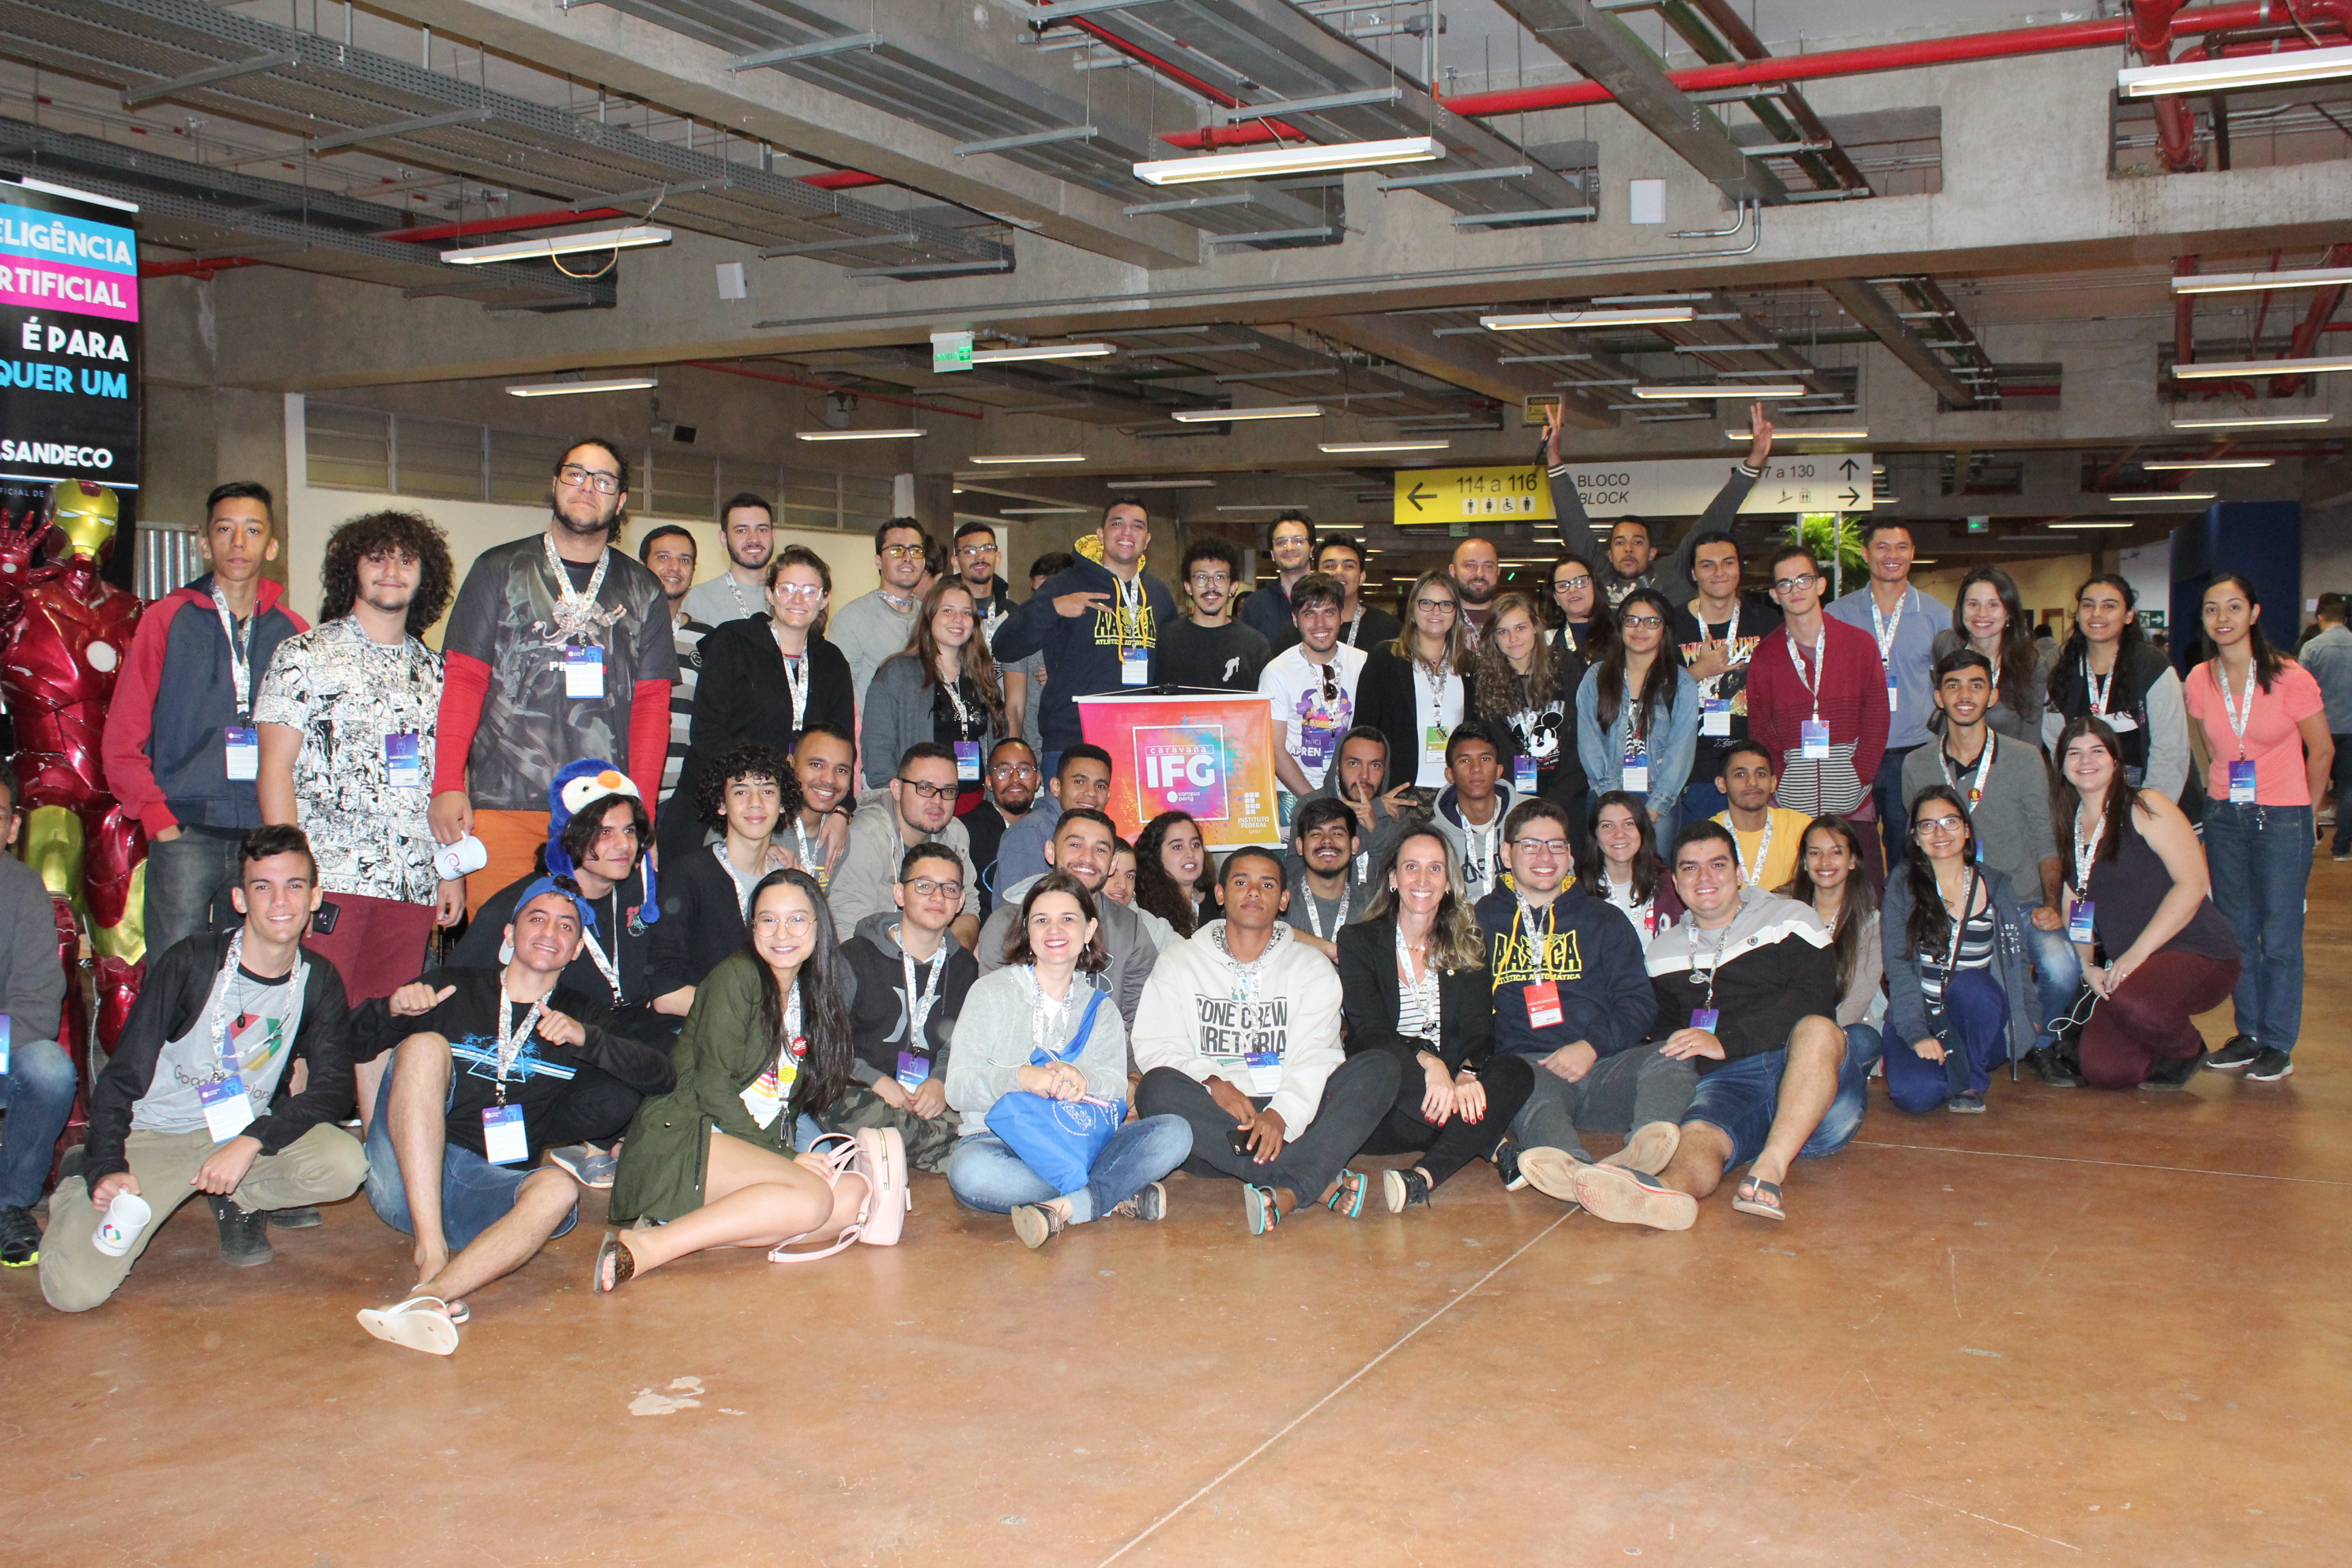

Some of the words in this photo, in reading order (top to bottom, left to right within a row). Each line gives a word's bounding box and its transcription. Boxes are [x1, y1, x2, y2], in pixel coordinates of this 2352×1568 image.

[22, 316, 42, 351] É
[48, 325, 129, 362] PARA
[0, 359, 74, 394] QUER
[80, 369, 128, 399] UM
[1776, 469, 1784, 478] a
[1791, 466, 1815, 478] 130
[1456, 476, 1484, 493] 114
[1491, 479, 1501, 492] a
[1509, 474, 1537, 492] 116
[1578, 473, 1630, 487] BLOCO
[32, 489, 45, 497] DE
[1579, 491, 1630, 504] BLOCK
[1150, 745, 1207, 754] caravana
[1145, 754, 1215, 788] IFG
[1497, 973, 1526, 985] TLÉTICA
